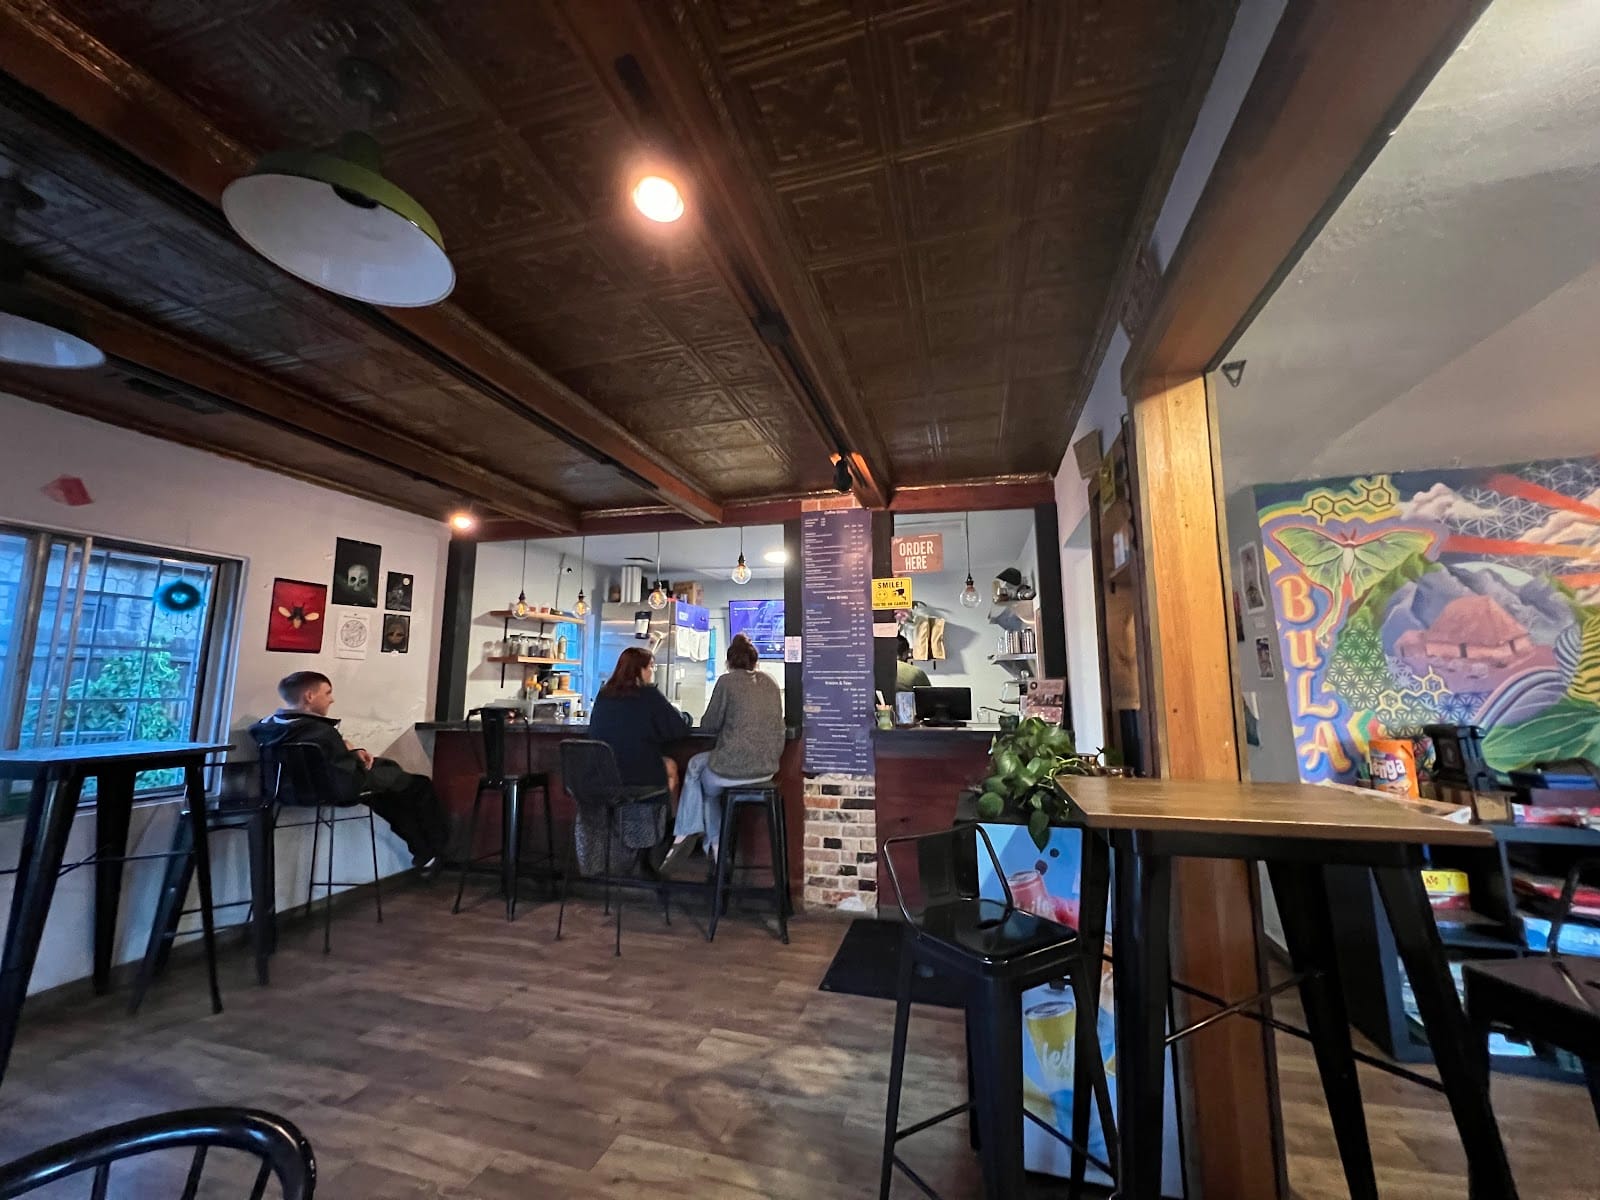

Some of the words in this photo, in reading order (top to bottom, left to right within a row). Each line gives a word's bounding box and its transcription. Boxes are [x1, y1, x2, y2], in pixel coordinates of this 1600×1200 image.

[899, 540, 934, 556] ORDER
[905, 555, 928, 570] HERE
[877, 581, 903, 589] SMILE!
